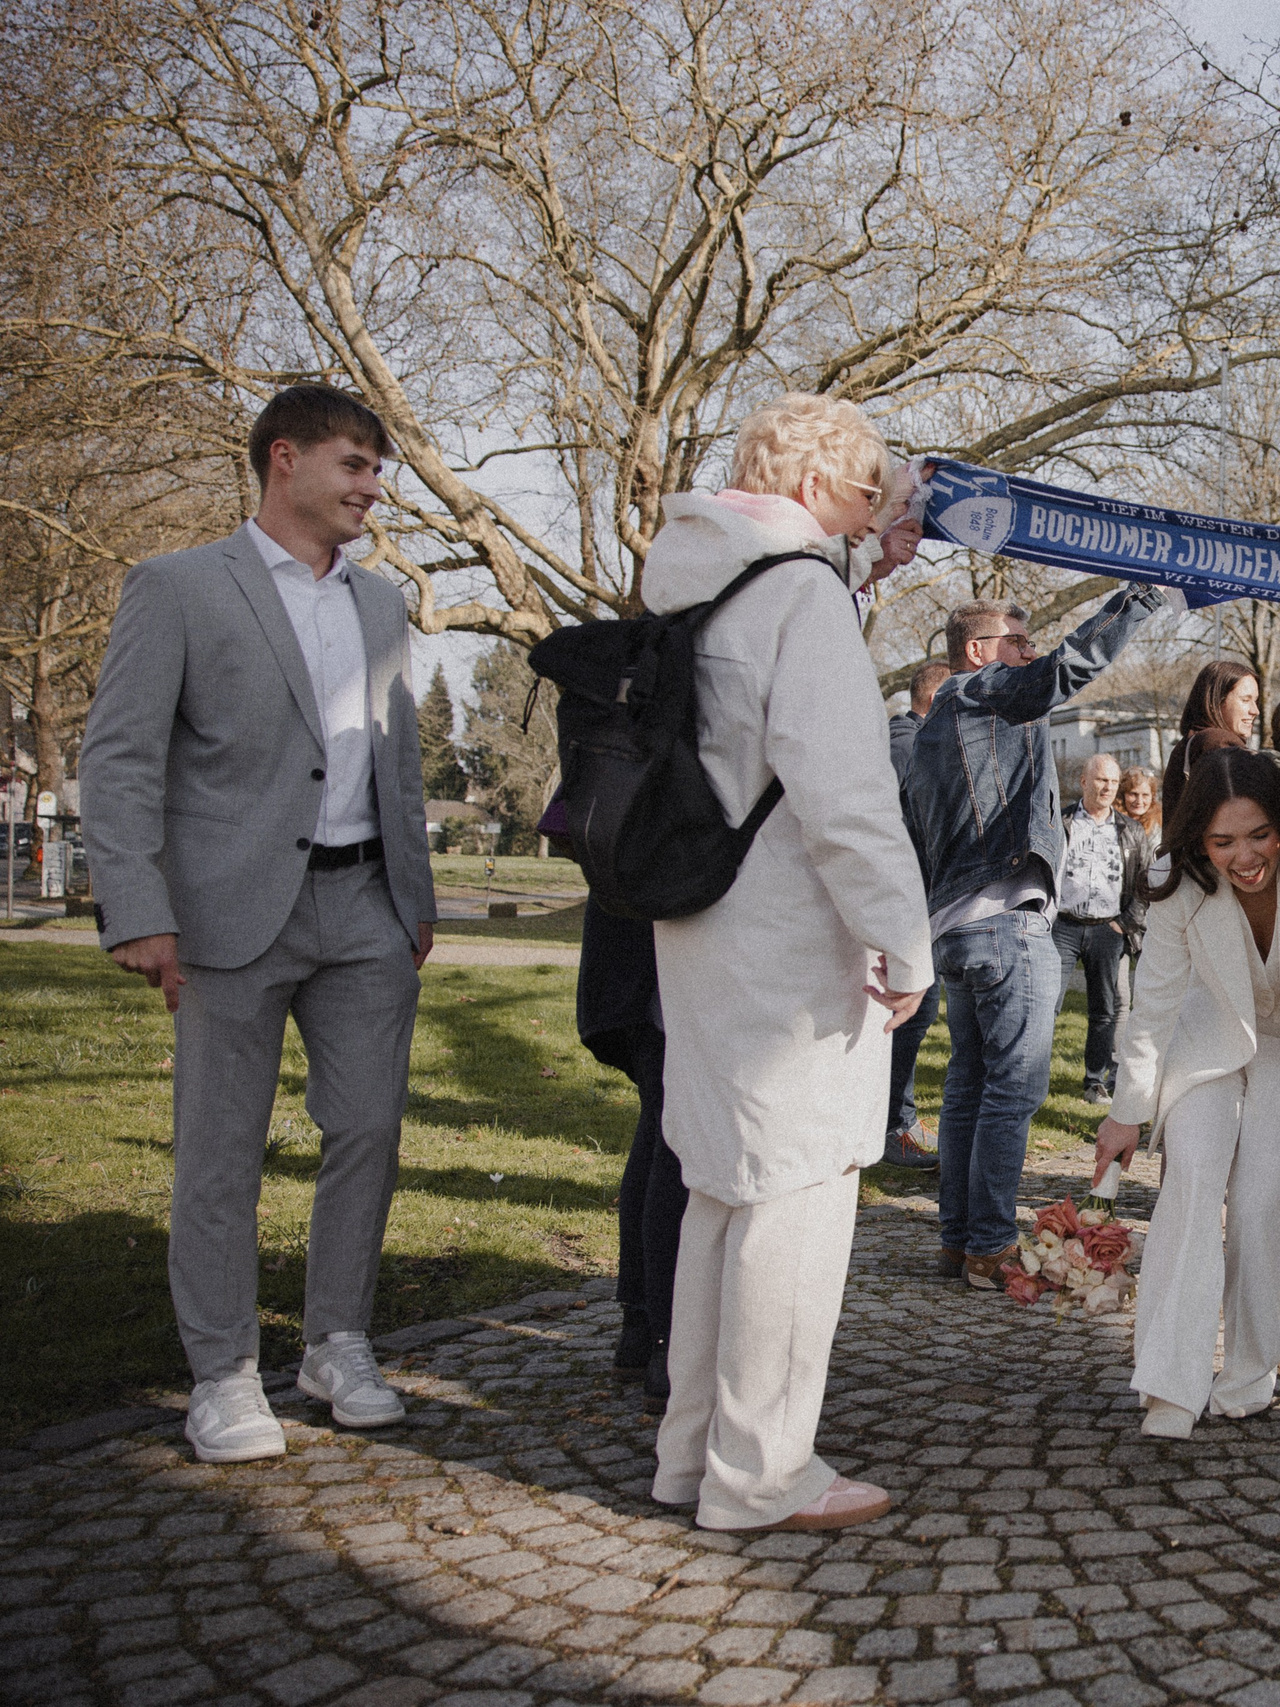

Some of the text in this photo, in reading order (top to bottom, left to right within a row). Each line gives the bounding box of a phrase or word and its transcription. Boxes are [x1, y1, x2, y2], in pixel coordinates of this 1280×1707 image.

[969, 511, 983, 532] 1848
[982, 507, 998, 541] Bochum
[1097, 500, 1139, 517] TIEF
[1143, 508, 1166, 522] IM
[1029, 505, 1172, 562] BOCHUMER
